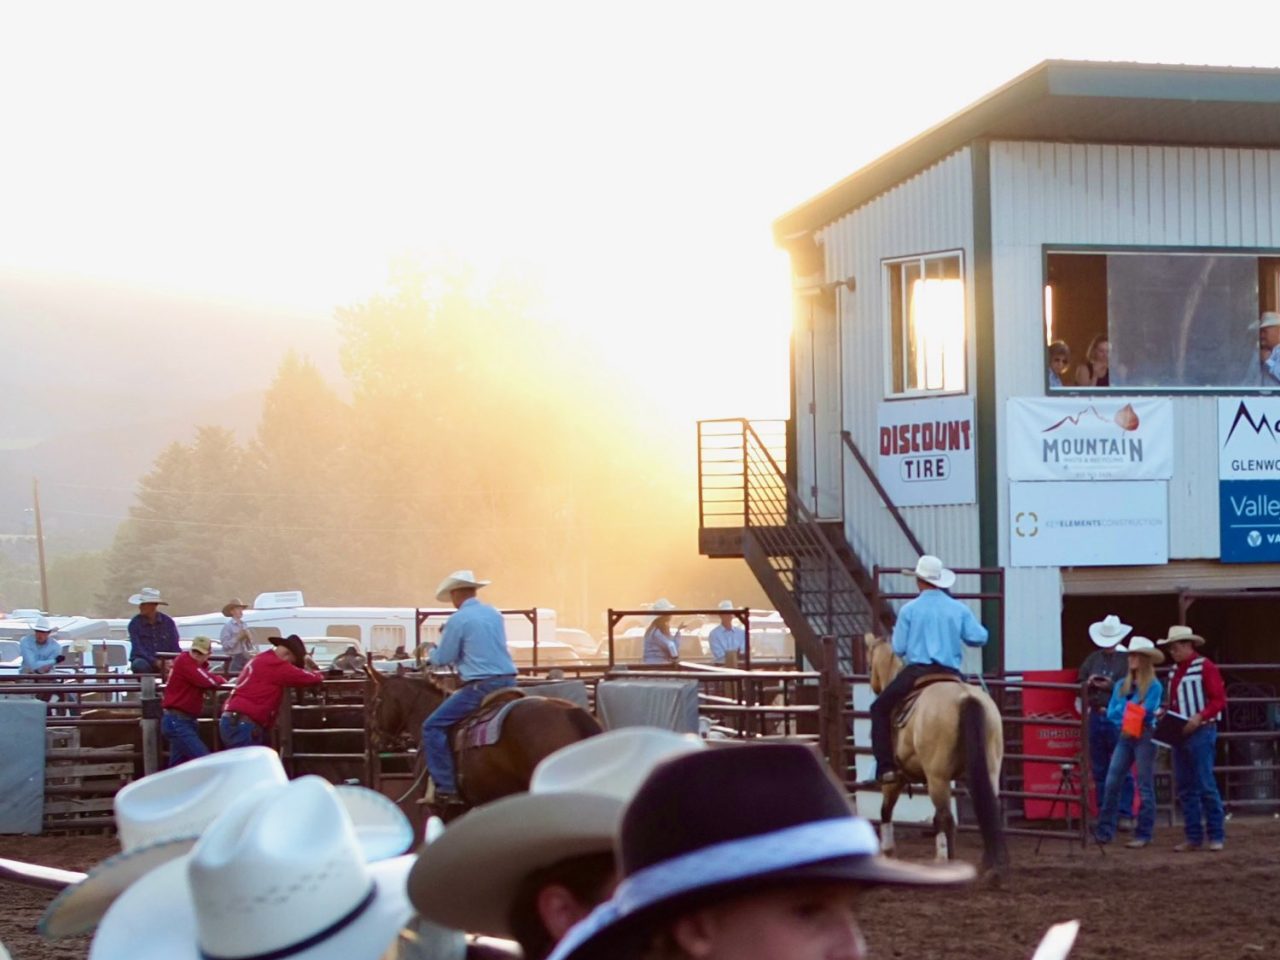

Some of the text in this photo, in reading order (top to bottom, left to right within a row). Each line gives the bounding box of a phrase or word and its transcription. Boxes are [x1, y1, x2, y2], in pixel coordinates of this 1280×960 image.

[880, 420, 970, 456] DISCOUNT
[1042, 438, 1144, 463] MOUNTAIN
[905, 458, 945, 479] TIRE
